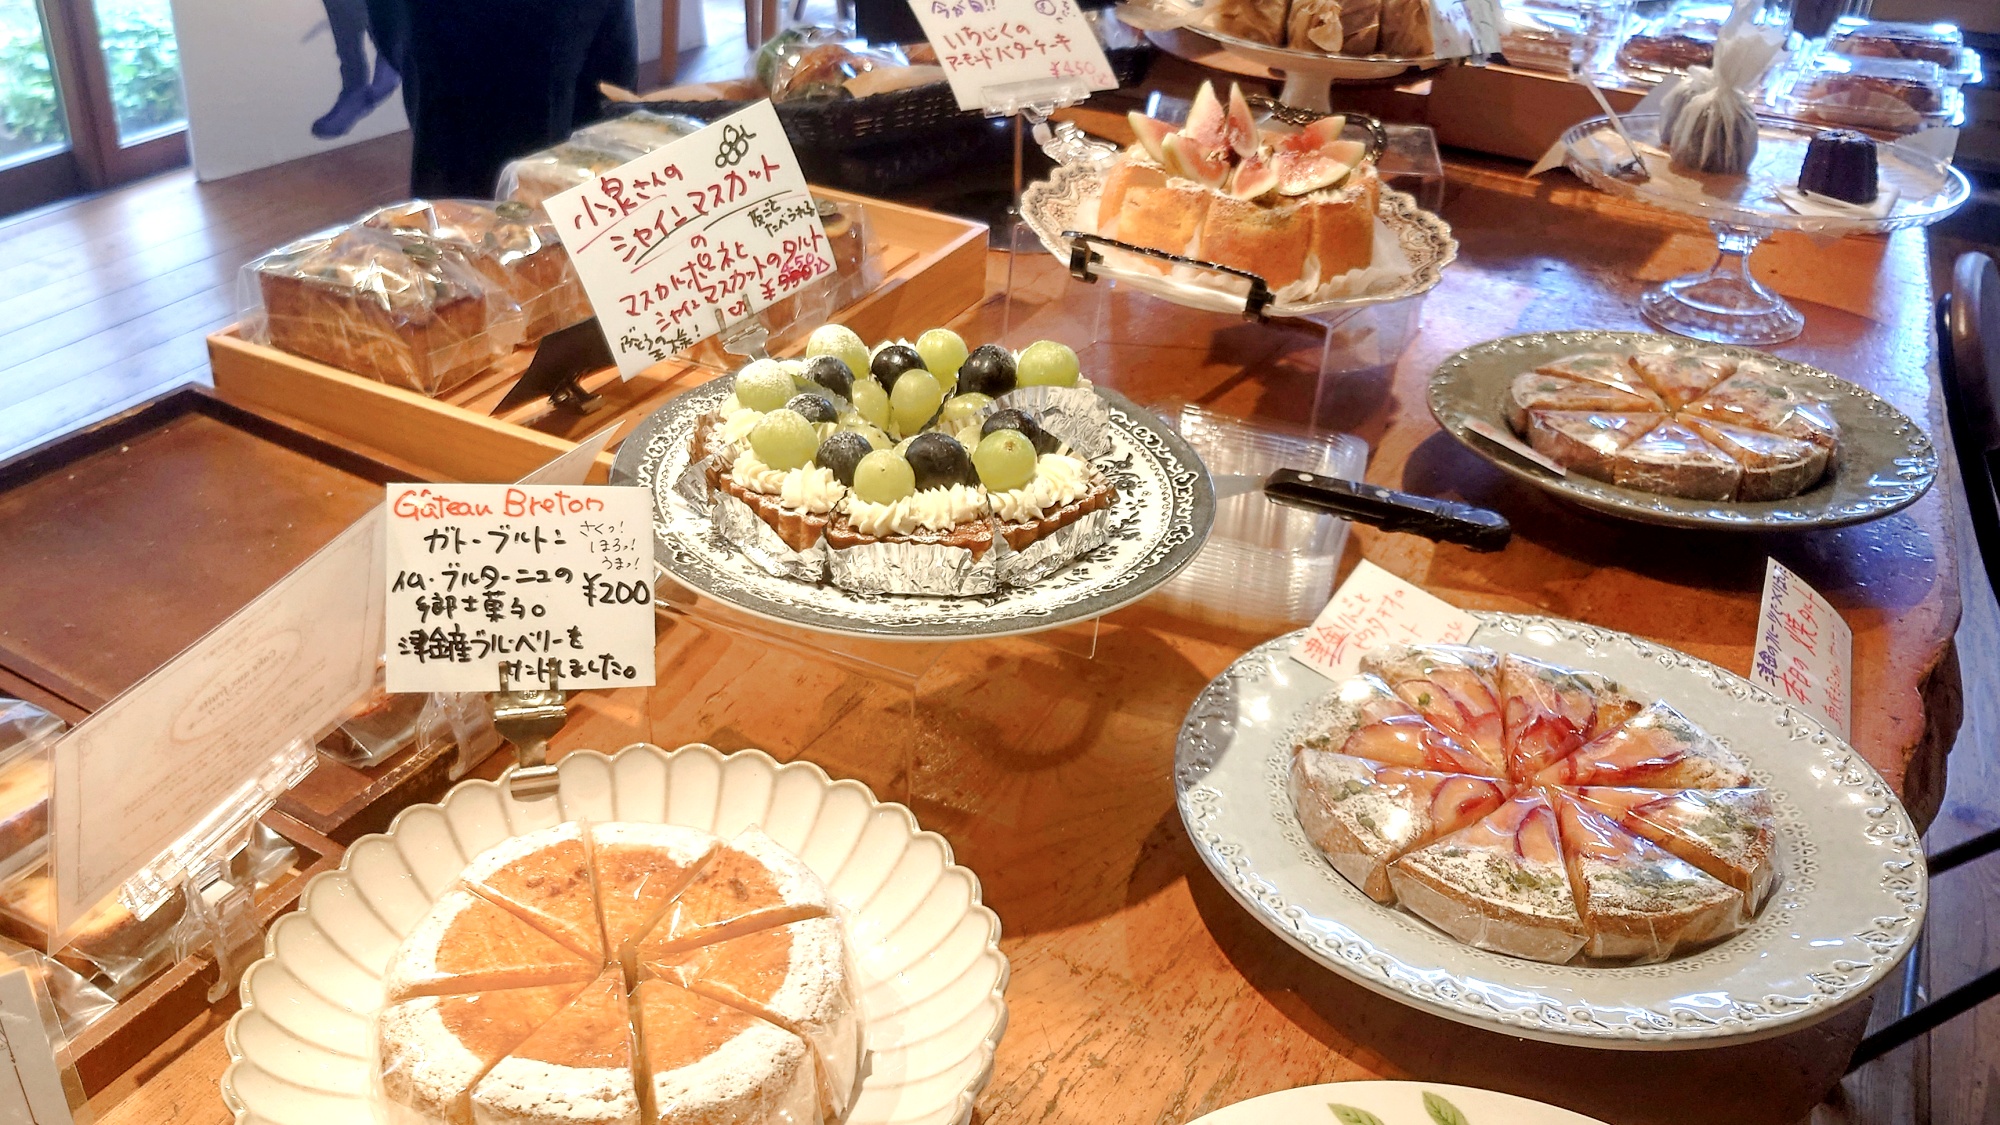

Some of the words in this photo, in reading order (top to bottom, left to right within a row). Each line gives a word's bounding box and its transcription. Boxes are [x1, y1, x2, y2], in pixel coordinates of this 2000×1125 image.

[943, 22, 1030, 50] いちじくの
[574, 163, 683, 230] 小泉さんの
[609, 155, 780, 263] シャインマスカット
[690, 234, 708, 249] の
[393, 488, 493, 521] Gâteau
[503, 488, 605, 519] Breton
[582, 572, 651, 608] ¥200
